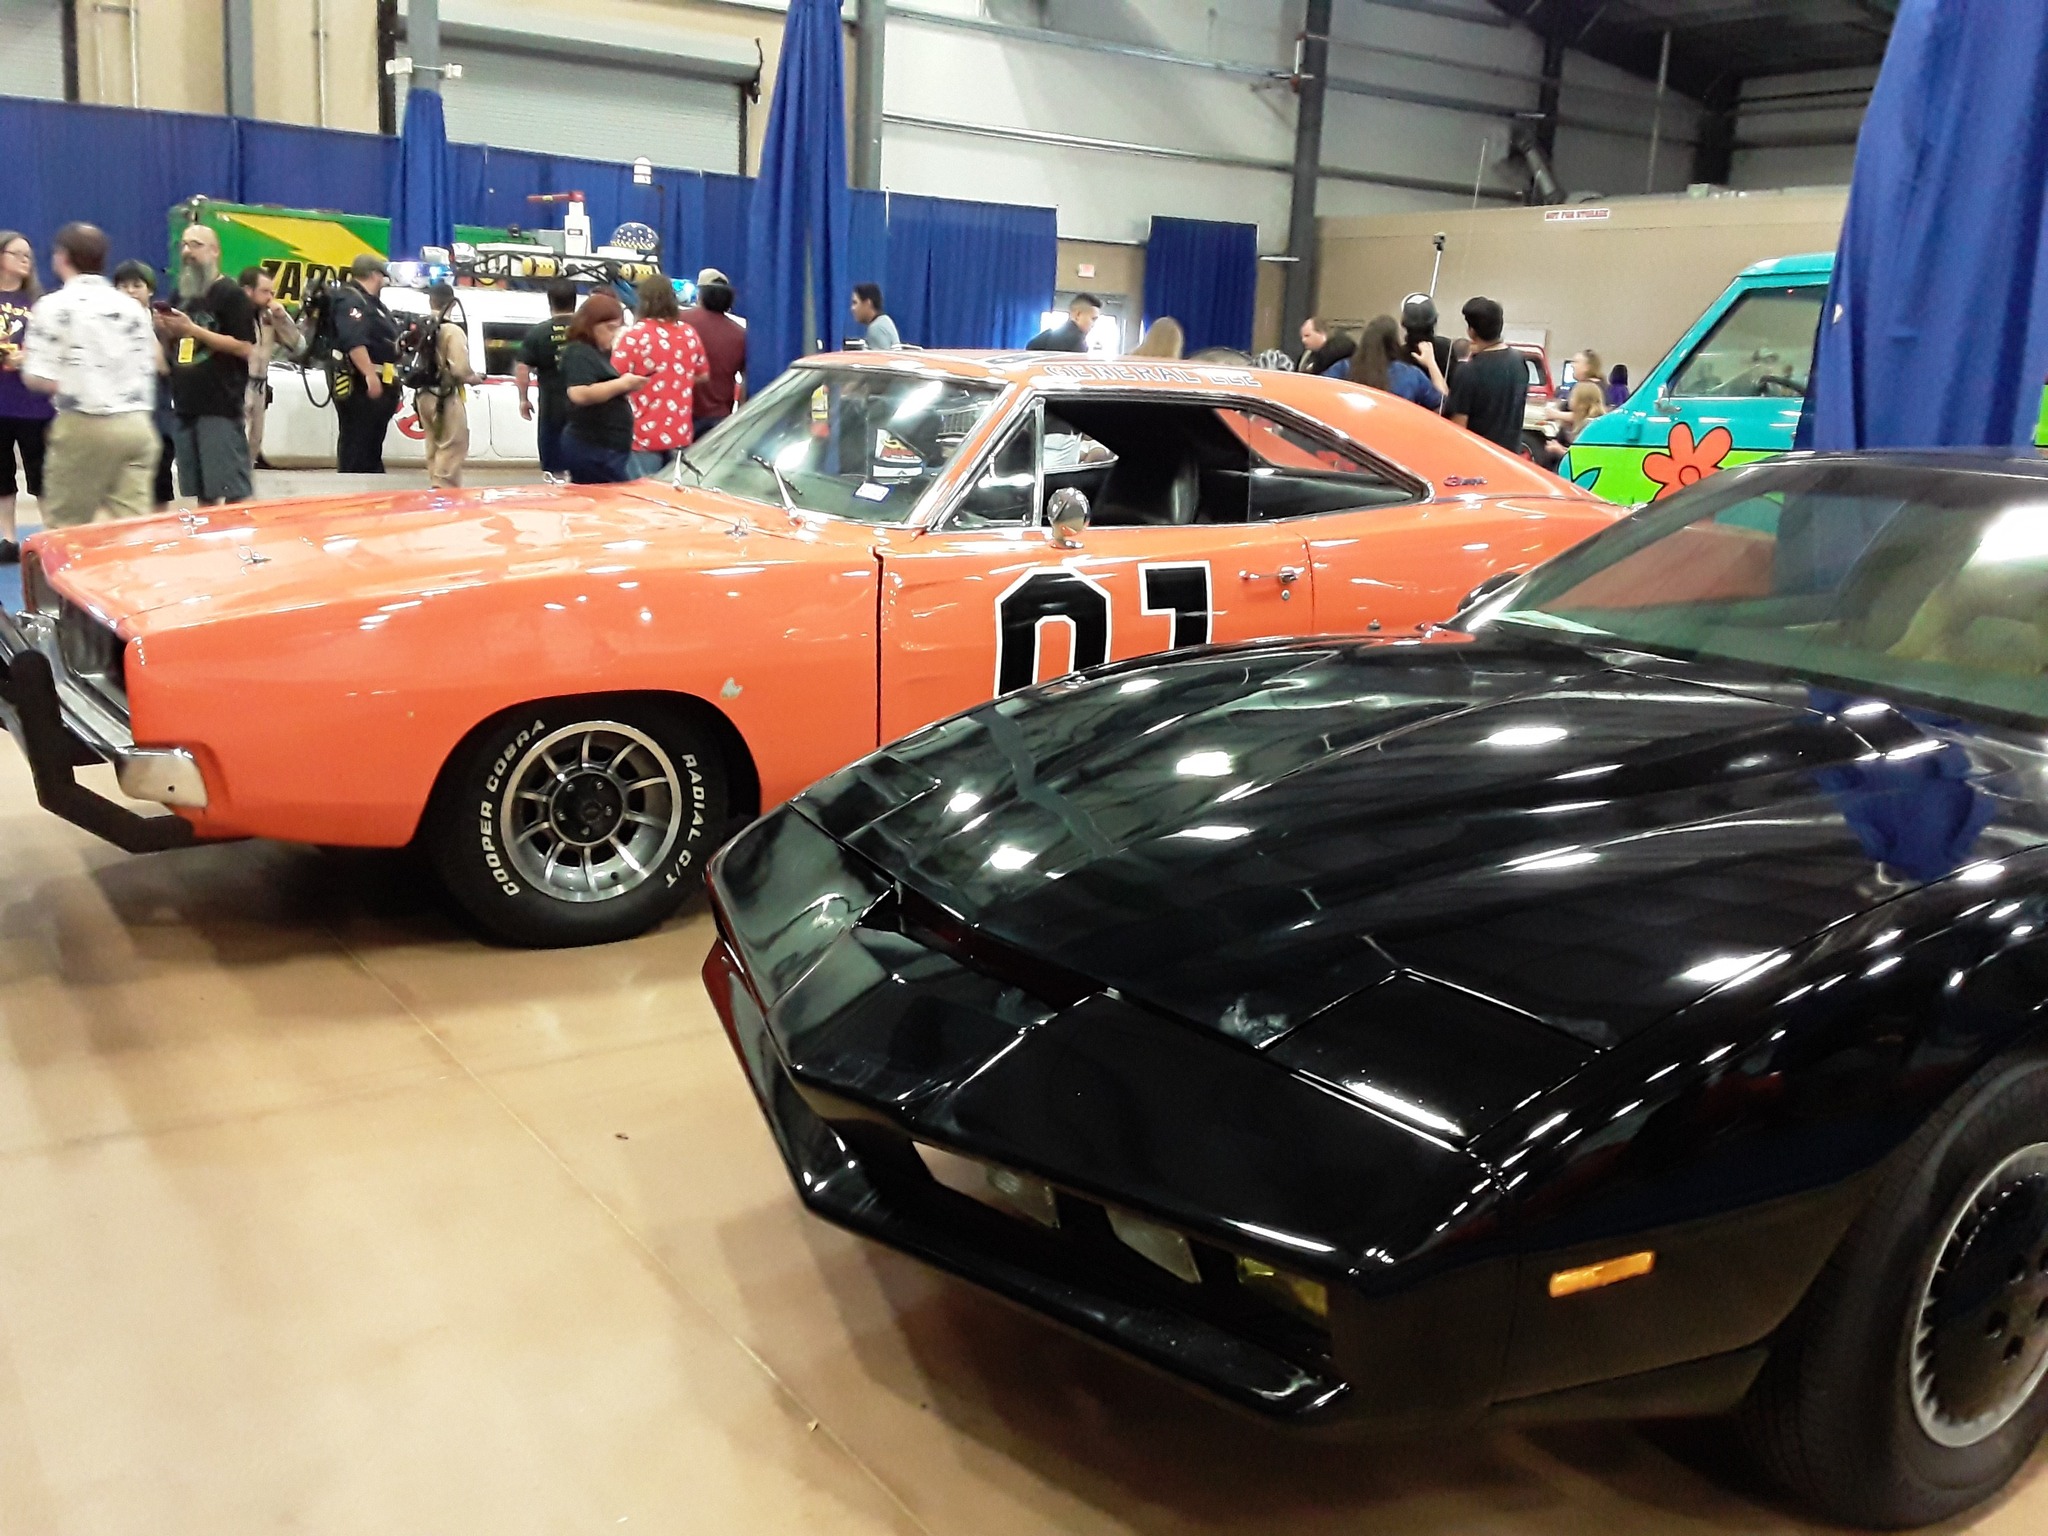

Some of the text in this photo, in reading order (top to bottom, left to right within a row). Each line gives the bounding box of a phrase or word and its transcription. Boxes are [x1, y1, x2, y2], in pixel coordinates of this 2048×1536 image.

[1043, 364, 1201, 384] GENERAL
[994, 560, 1212, 699] 01
[480, 719, 546, 896] COOPER COBRA
[665, 754, 706, 889] RADIAL G/T
